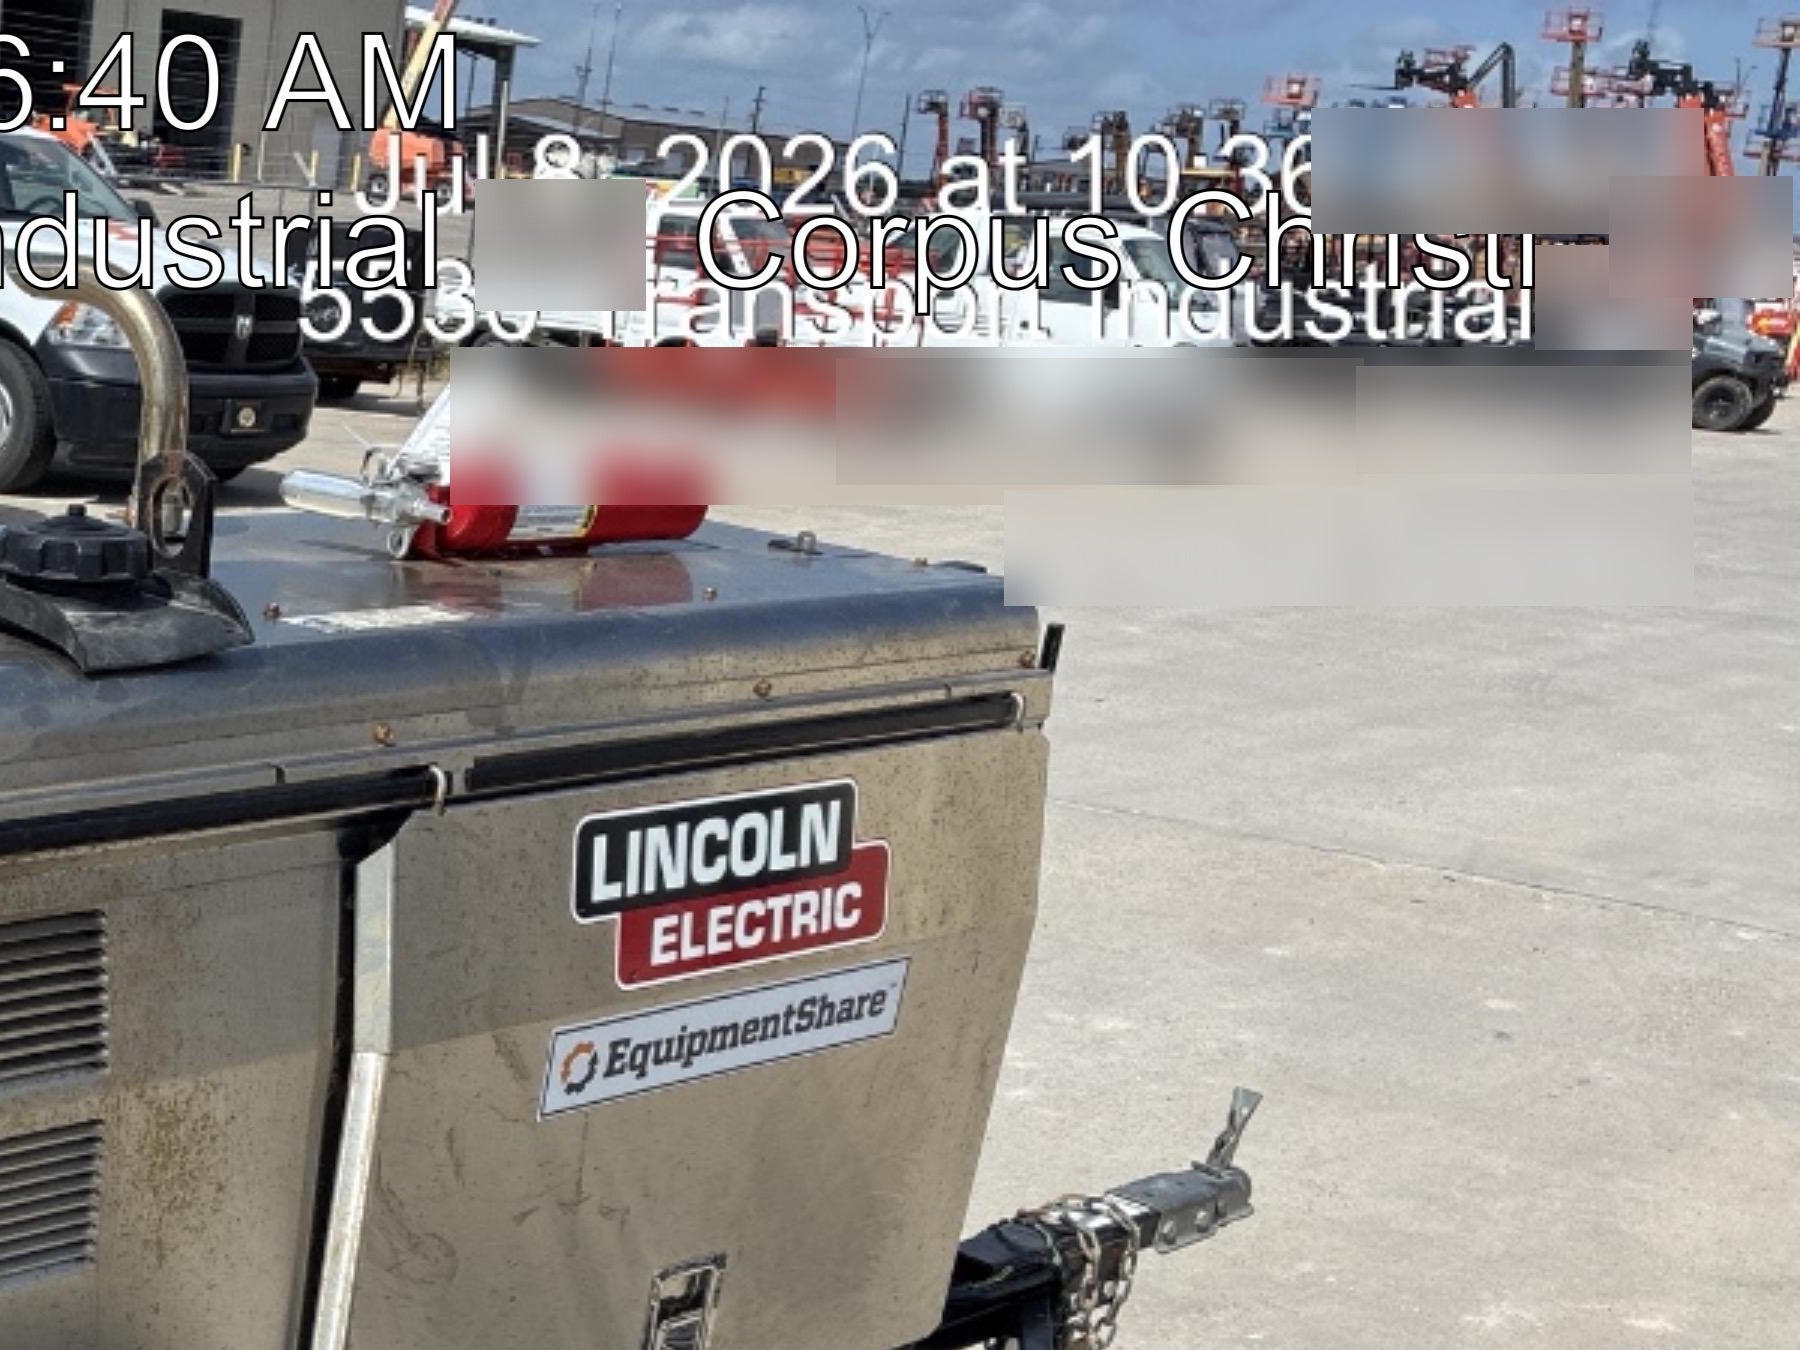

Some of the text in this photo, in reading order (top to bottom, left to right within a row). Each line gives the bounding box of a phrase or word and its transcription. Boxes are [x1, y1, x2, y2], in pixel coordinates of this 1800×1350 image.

[590, 799, 842, 903] LINCOLN
[649, 881, 863, 967] ELECTRIC
[602, 988, 888, 1081] EquipmentShare
